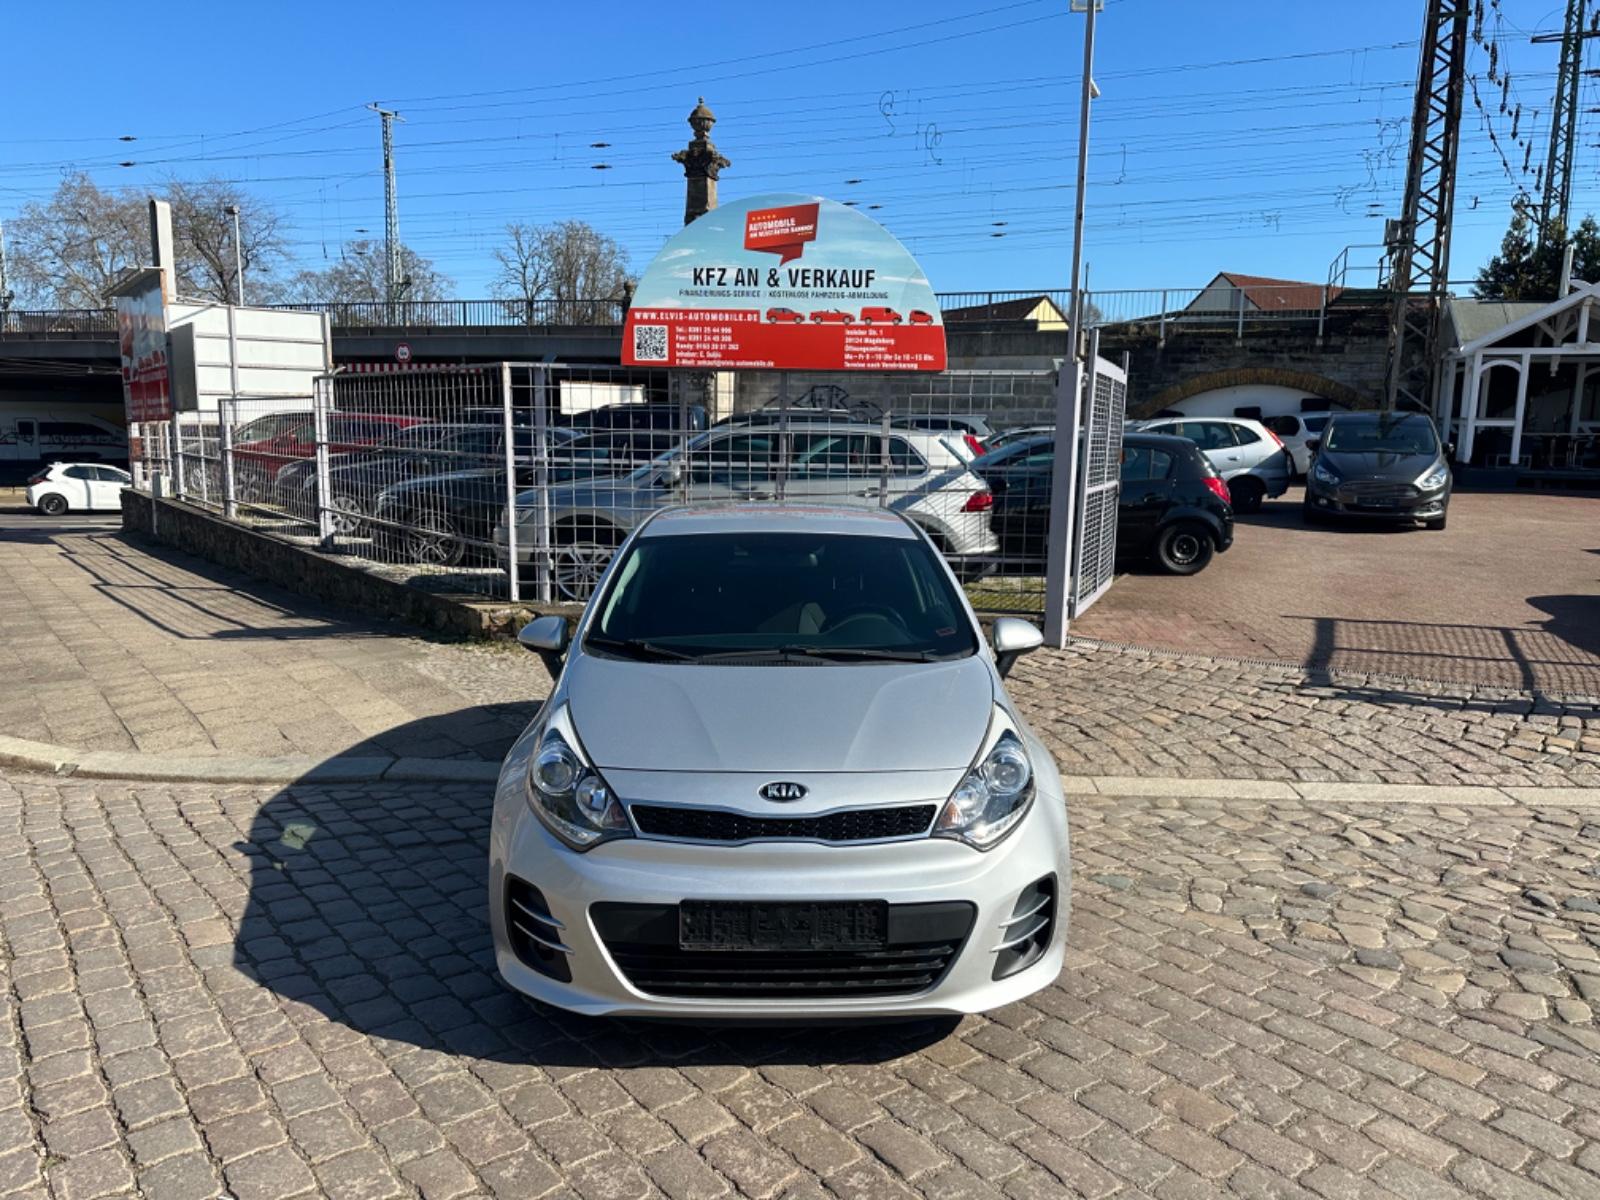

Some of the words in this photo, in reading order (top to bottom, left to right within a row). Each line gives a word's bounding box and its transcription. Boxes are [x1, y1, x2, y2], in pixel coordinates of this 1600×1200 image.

[749, 217, 795, 231] AUTOMOBILE
[693, 268, 727, 286] KFZ
[734, 268, 758, 287] AN
[767, 268, 780, 288] &
[788, 268, 875, 288] VERKAUF
[634, 312, 758, 321] WWW.ELVIS-AUTOMOBILE.DE
[767, 783, 801, 798] KIA
